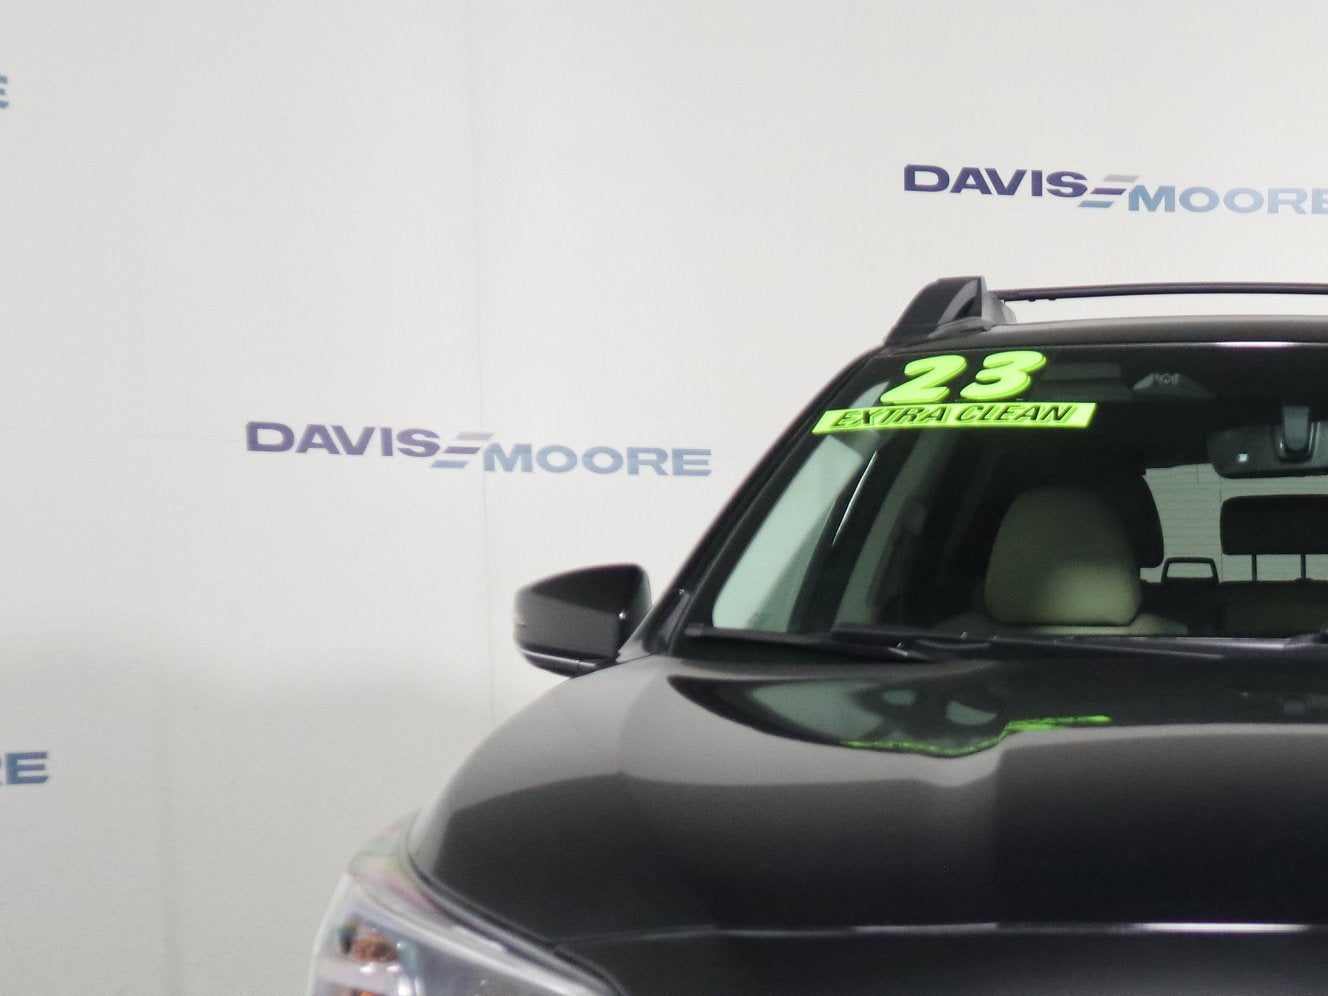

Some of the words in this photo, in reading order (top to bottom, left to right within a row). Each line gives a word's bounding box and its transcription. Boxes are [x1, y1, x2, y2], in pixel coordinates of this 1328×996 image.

[903, 163, 1088, 199] DAVIS
[880, 350, 1047, 404] 23
[831, 404, 951, 429] EXTRA
[954, 402, 1079, 424] CLEAN
[245, 420, 441, 458] DAVIS
[483, 443, 712, 478] MOORE
